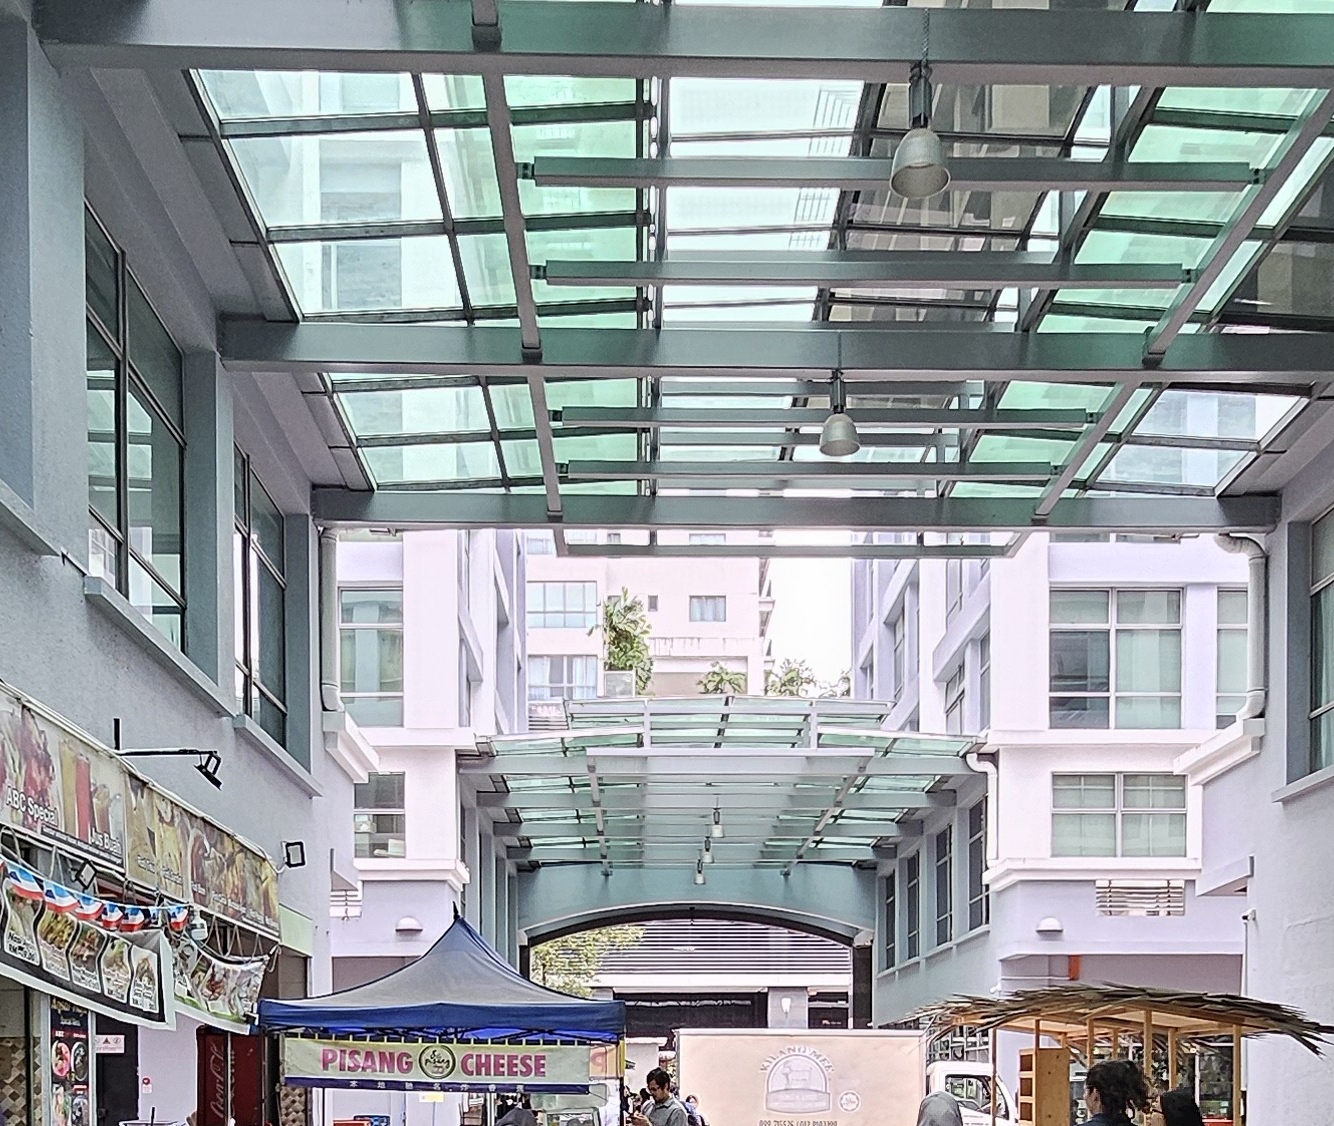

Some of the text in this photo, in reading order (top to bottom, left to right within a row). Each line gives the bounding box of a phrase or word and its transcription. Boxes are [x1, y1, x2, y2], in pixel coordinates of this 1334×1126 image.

[6, 785, 58, 828] ABC Special
[320, 1048, 546, 1078] PISANG CHEESE
